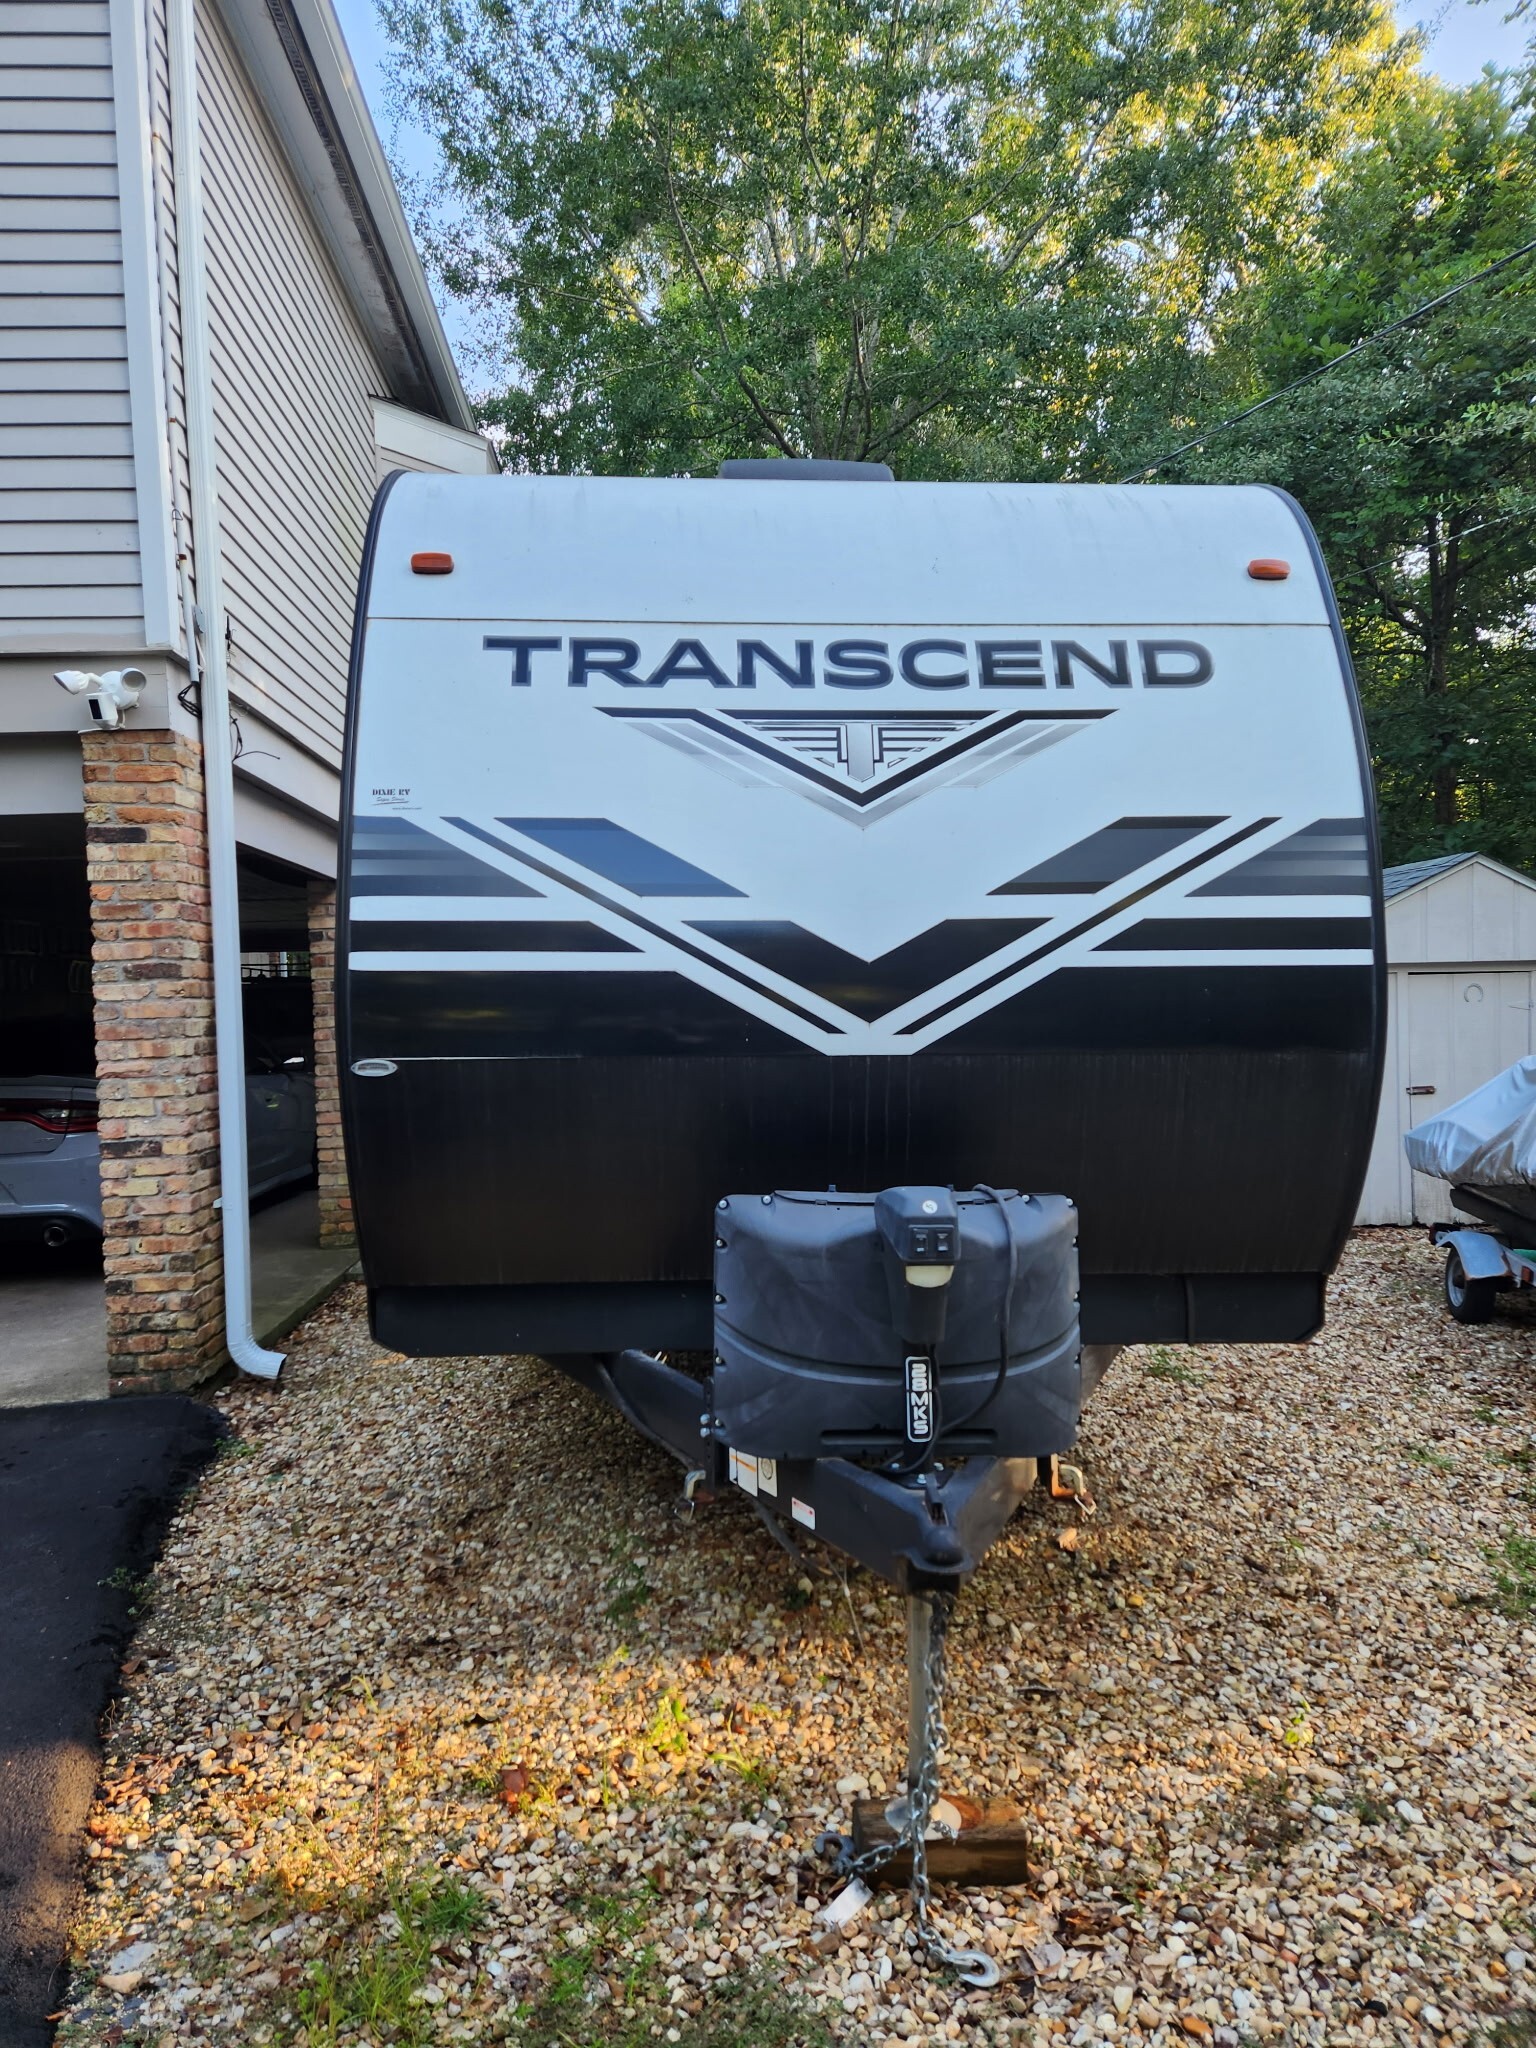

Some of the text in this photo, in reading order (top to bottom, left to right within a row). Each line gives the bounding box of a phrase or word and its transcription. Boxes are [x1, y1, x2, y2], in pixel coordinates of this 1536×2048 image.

[482, 635, 1215, 691] TRANSCEND
[372, 788, 411, 796] DIXIE RV
[910, 1363, 929, 1435] 28MKS
